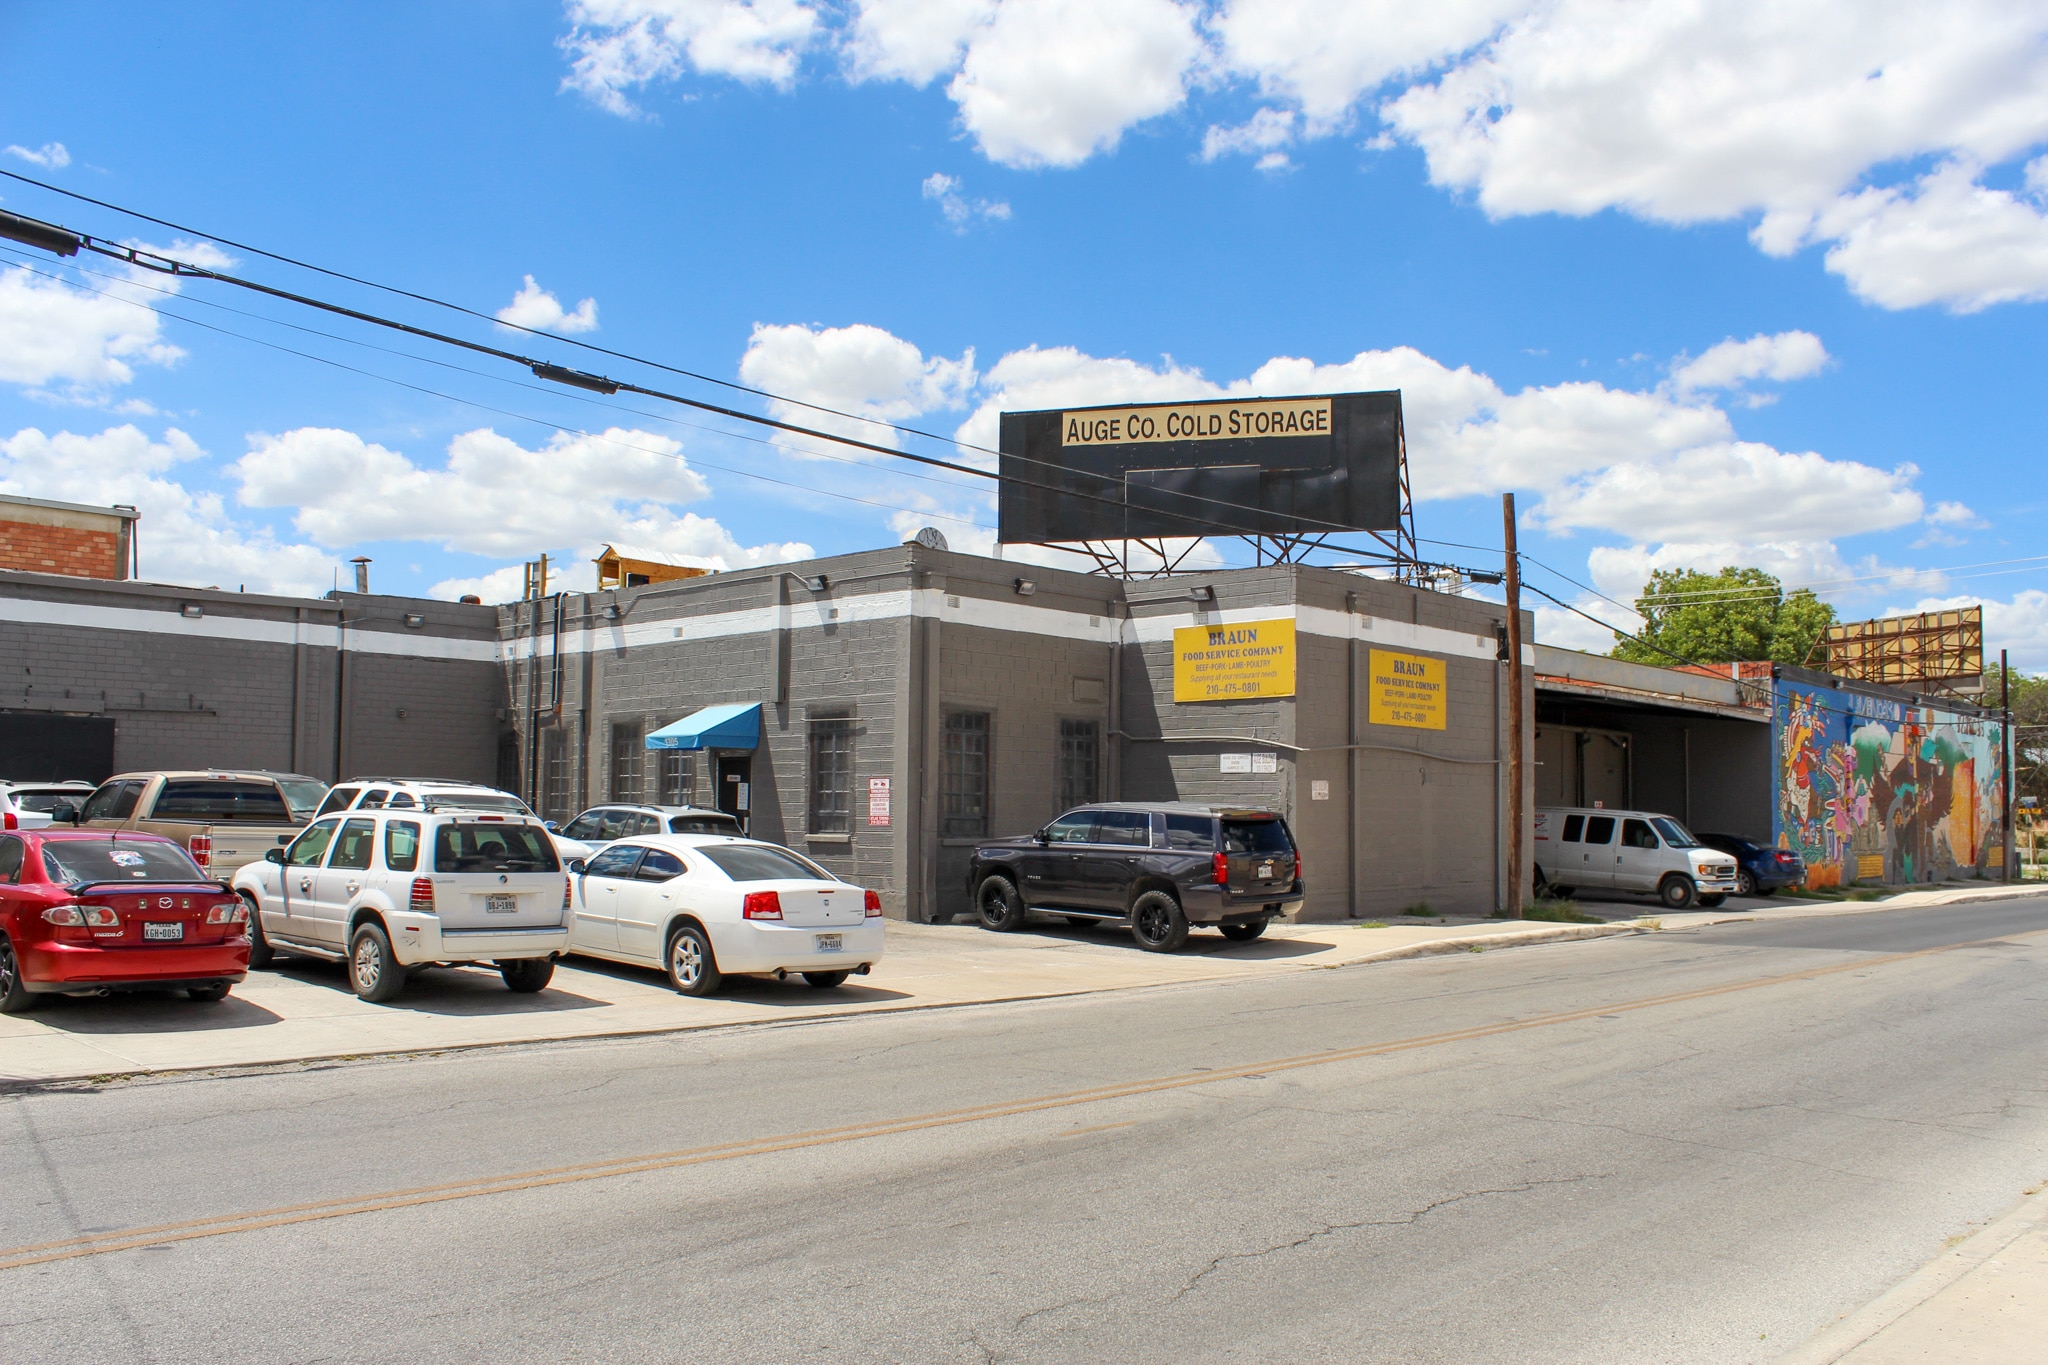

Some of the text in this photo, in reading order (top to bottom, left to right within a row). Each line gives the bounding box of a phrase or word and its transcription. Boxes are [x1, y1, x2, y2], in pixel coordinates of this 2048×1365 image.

[1067, 409, 1328, 442] AUGE CO. COLD STORAGE
[1209, 629, 1258, 646] BRAUN
[1183, 645, 1284, 661] FOOD SERVICE COMPANY
[1393, 660, 1425, 677] BRAUN
[1206, 682, 1260, 694] 210-475-0801
[1376, 675, 1440, 692] FOOD SERVICE COMPANY
